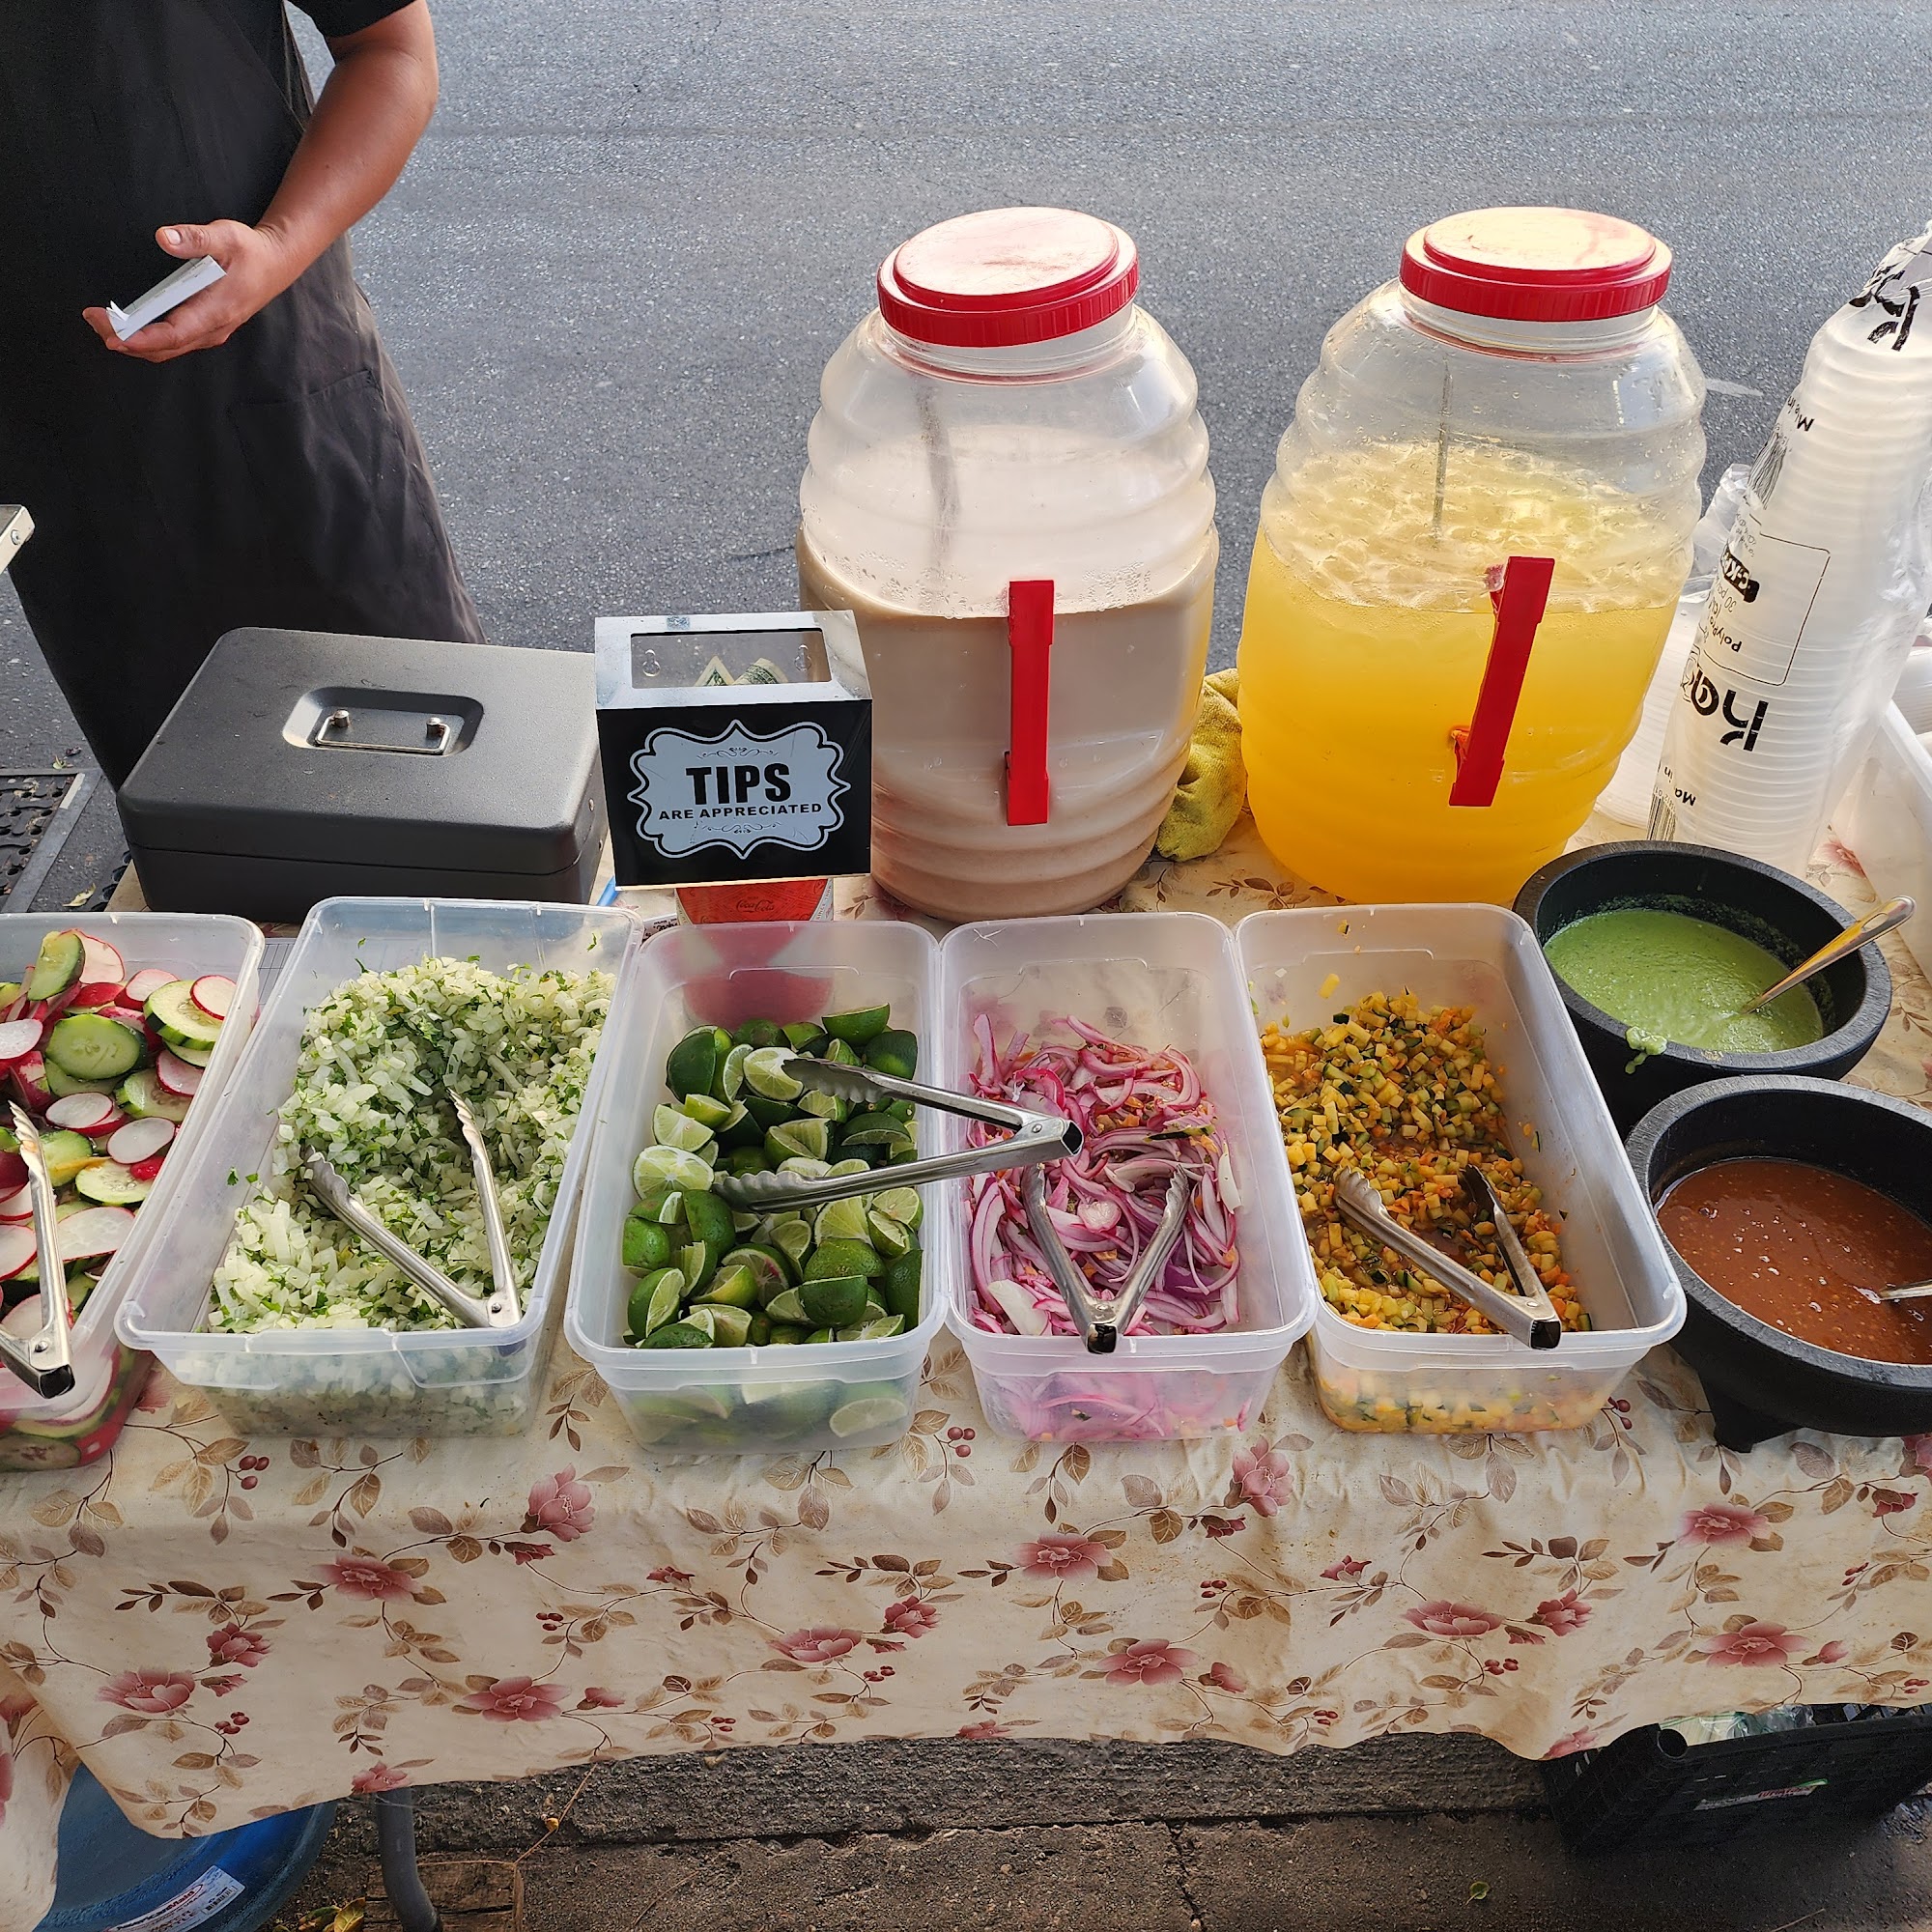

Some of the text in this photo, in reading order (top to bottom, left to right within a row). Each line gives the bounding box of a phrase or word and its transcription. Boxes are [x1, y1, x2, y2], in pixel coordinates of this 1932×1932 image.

[685, 762, 791, 806] TIPS
[659, 803, 822, 820] ARE APPRECIATED
